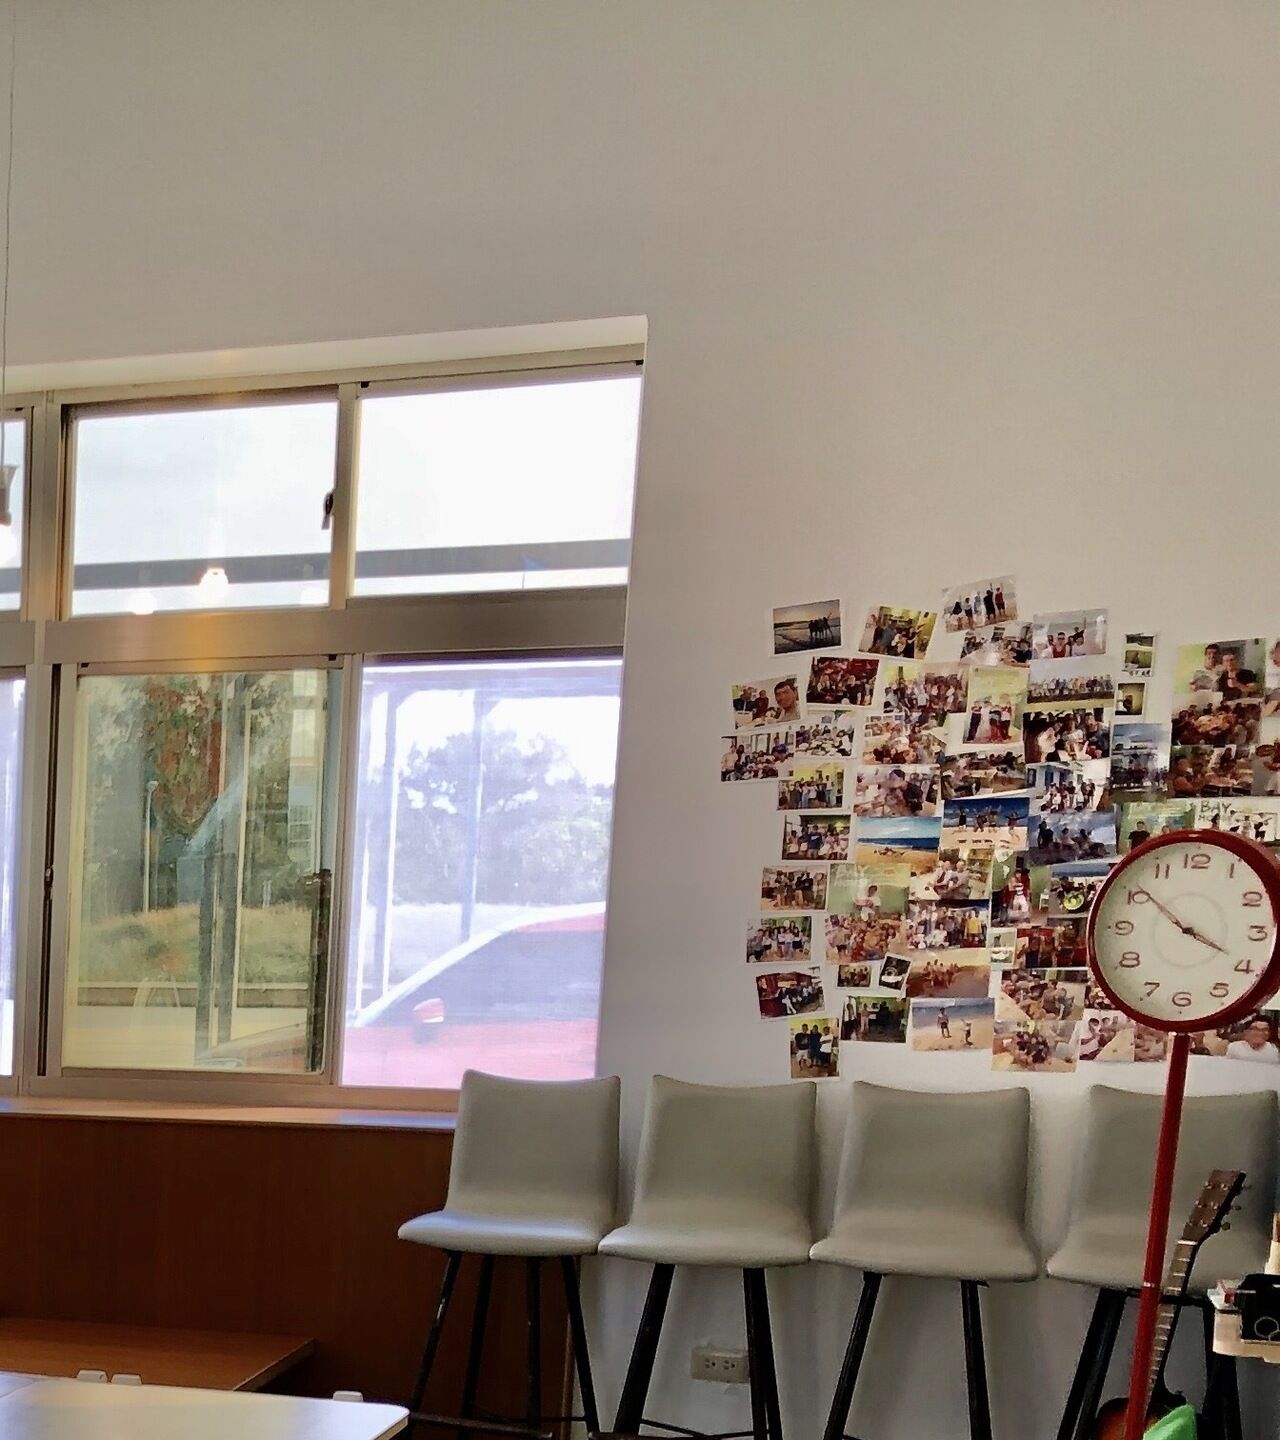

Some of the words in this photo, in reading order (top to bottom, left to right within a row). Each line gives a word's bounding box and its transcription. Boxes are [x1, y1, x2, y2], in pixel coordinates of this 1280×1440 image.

[1201, 801, 1232, 813] BAY
[1183, 853, 1211, 870] 12
[1155, 863, 1170, 879] 11
[1228, 863, 1235, 879] 1
[1127, 890, 1151, 905] 10
[1242, 891, 1263, 907] 2
[1115, 920, 1134, 936] 9
[1248, 925, 1268, 941] 3
[1119, 952, 1140, 968] 8
[1234, 959, 1254, 974] 4
[1144, 982, 1160, 997] 7
[1209, 982, 1229, 998] 5
[1172, 992, 1191, 1007] 6
